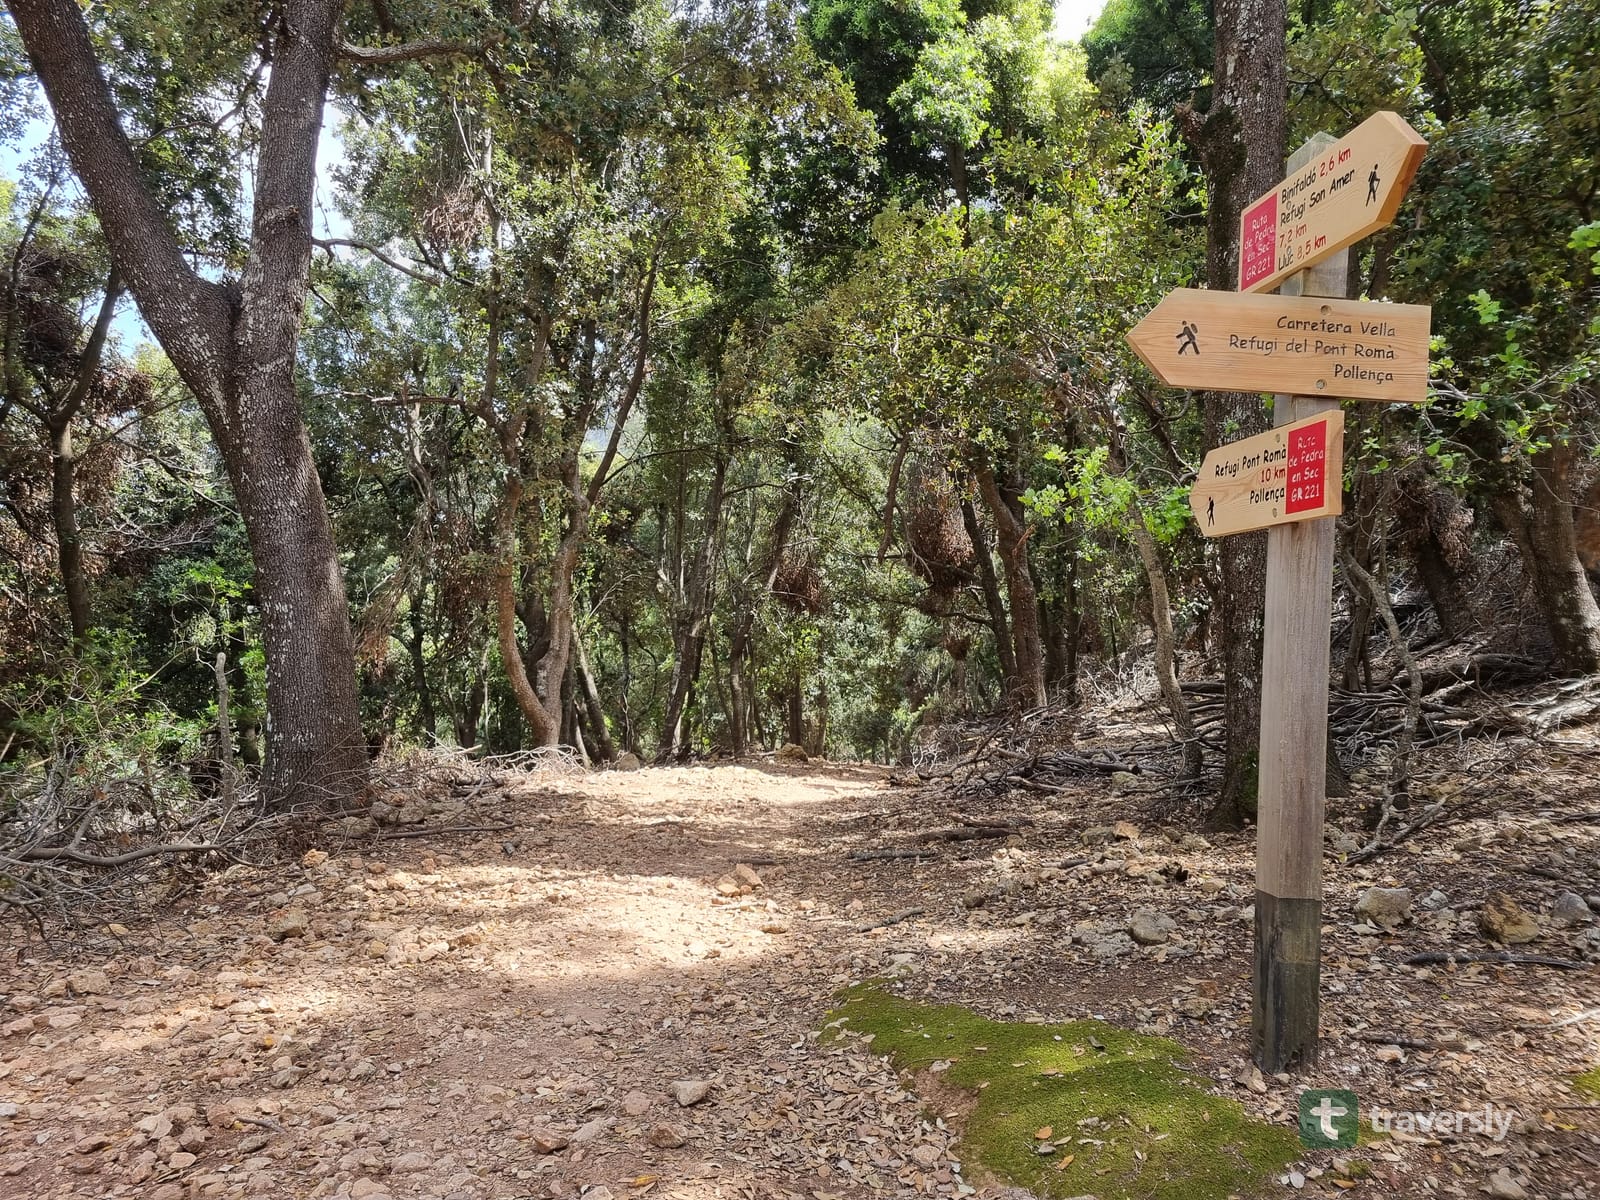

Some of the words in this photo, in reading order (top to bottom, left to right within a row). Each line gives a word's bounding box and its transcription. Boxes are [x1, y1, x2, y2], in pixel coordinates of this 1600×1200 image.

[1281, 167, 1316, 204] Binifaldó
[1320, 156, 1335, 177] 2,6
[1338, 147, 1351, 163] km
[1280, 202, 1306, 227] Refugi
[1309, 189, 1325, 207] Son
[1330, 168, 1355, 193] Amer
[1252, 214, 1268, 230] Ruta
[1244, 238, 1254, 250] de
[1255, 224, 1275, 242] Pedra
[1279, 229, 1293, 248] 7,2
[1296, 222, 1307, 239] km
[1296, 239, 1311, 259] 8,5
[1314, 233, 1327, 249] km
[1247, 251, 1256, 263] en
[1257, 242, 1270, 256] Sec
[1246, 265, 1257, 281] GR
[1257, 257, 1271, 274] 221
[1277, 315, 1352, 334] Carretera
[1360, 321, 1396, 338] Vella
[1229, 334, 1278, 356] Refugi
[1286, 337, 1307, 353] del
[1315, 341, 1347, 357] Pont
[1354, 343, 1395, 360] Romà
[1334, 364, 1394, 384] Pollença
[1215, 459, 1240, 479] Refugi
[1242, 453, 1260, 470] Pont
[1263, 443, 1287, 464] Romà
[1288, 454, 1298, 468] de
[1300, 449, 1325, 465] Pedra
[1261, 468, 1271, 483] 10
[1274, 464, 1286, 480] km
[1291, 472, 1301, 483] en
[1304, 466, 1319, 480] Sec
[1250, 486, 1285, 505] Pollença
[1291, 489, 1303, 503] GR
[1305, 484, 1320, 499] 221
